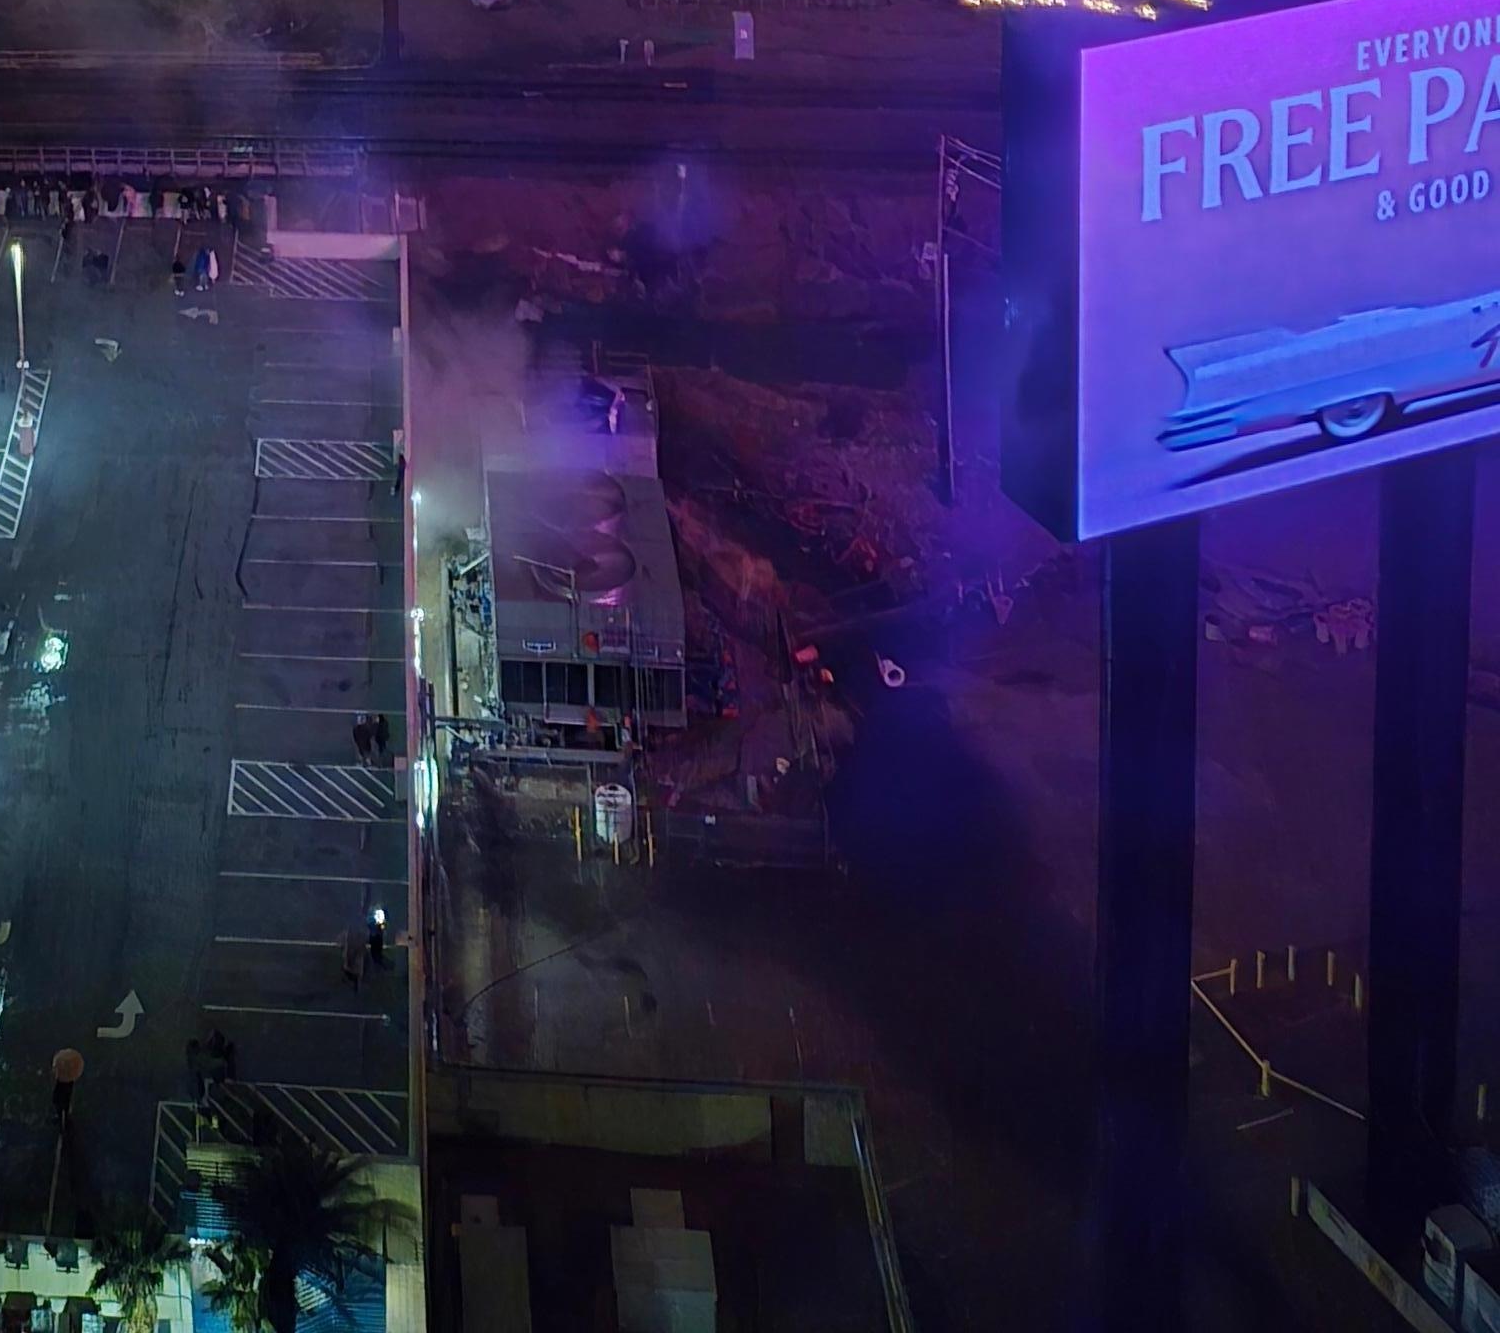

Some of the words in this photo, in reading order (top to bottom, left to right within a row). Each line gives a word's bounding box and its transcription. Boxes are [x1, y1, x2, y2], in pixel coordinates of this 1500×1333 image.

[1141, 78, 1382, 222] FREE
[1376, 189, 1396, 221] &
[1408, 169, 1490, 214] GOOD
